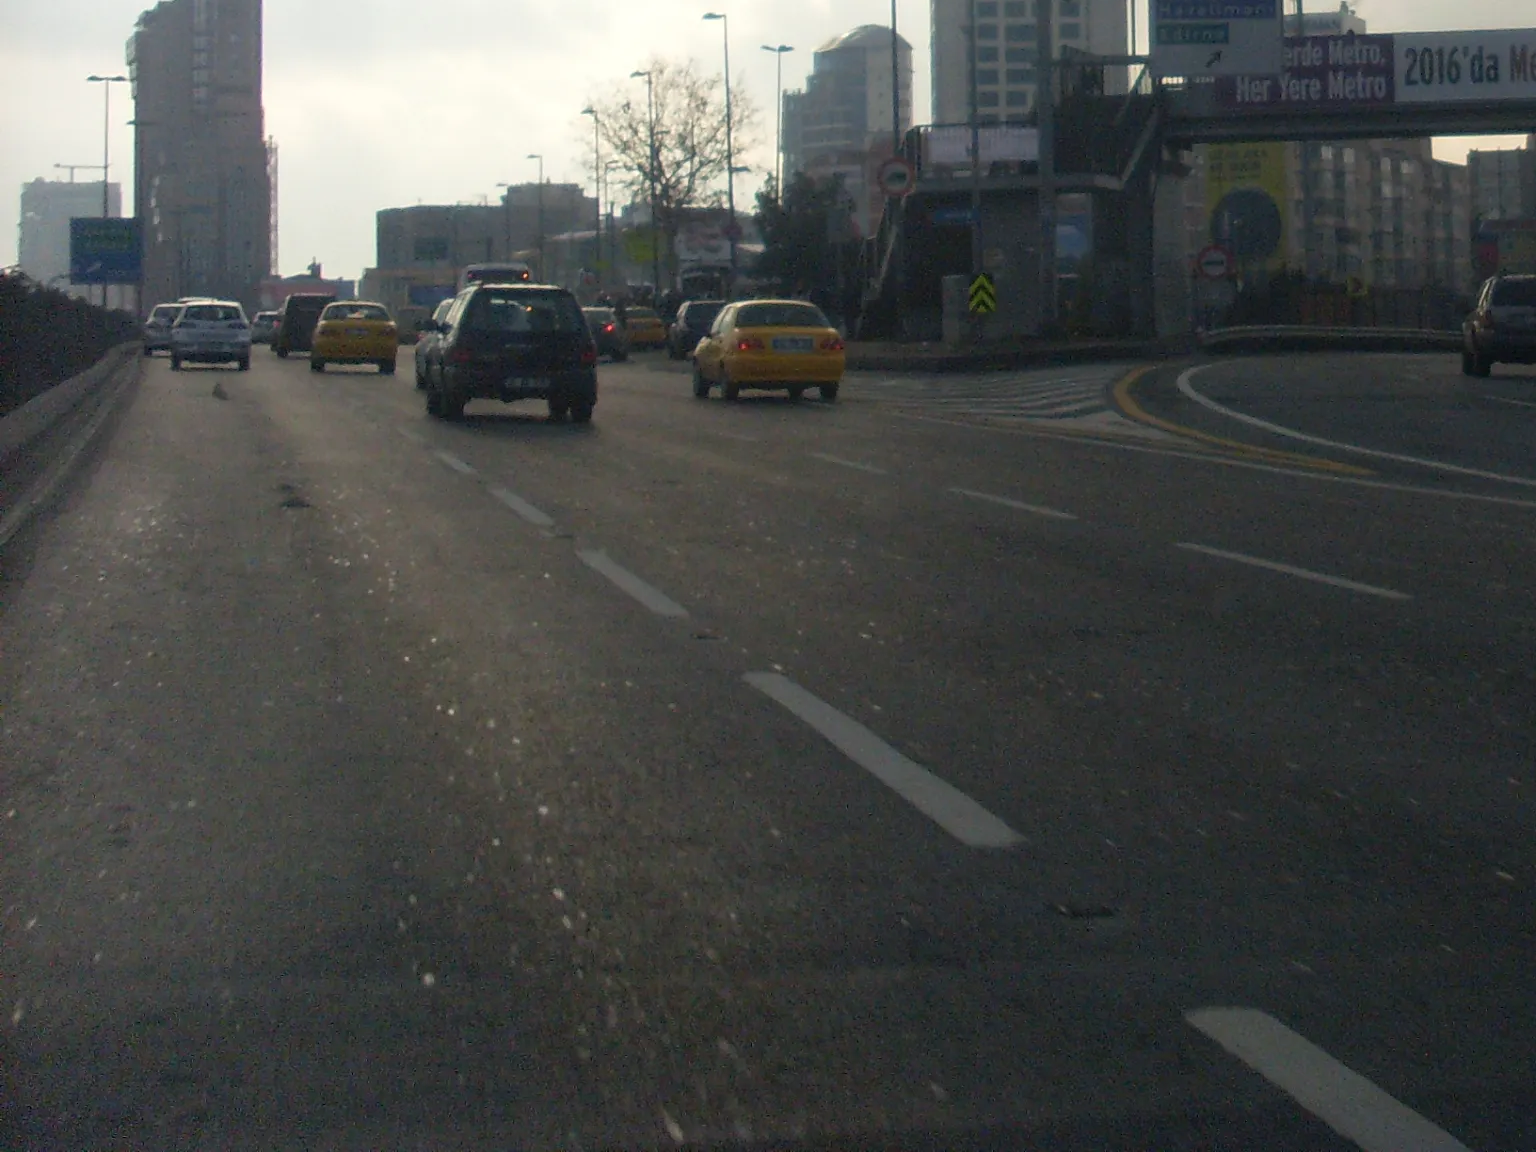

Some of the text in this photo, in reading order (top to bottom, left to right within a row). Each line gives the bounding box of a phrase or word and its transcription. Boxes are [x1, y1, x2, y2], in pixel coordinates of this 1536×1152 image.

[1284, 41, 1323, 66] erde
[1404, 44, 1500, 86] 2016'da
[1236, 71, 1387, 102] Her Yere Metro
